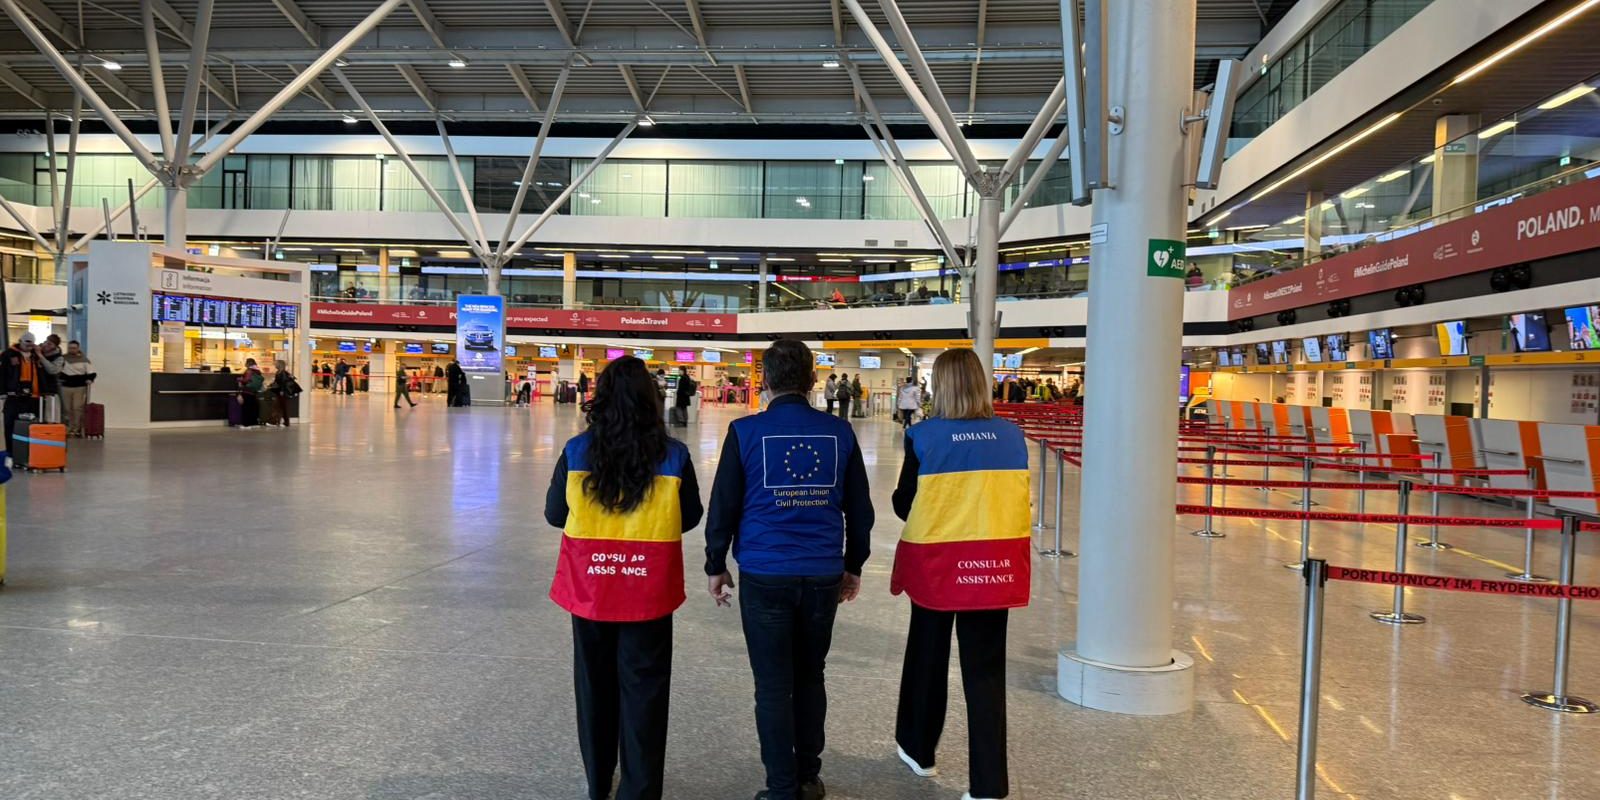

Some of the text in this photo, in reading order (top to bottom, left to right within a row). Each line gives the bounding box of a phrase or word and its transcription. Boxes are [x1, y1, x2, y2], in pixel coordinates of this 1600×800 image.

[1517, 206, 1584, 240] POLAND.
[1171, 258, 1185, 270] AED
[621, 317, 668, 325] Poland.Travel
[952, 432, 997, 442] ROMANIA
[773, 488, 830, 498] European Union
[792, 499, 829, 507] Protection
[957, 559, 1011, 569] CONSULAR
[587, 566, 647, 577] ASSISANCE
[956, 574, 1014, 584] ASSISTANCE
[1341, 569, 1377, 582] PORT
[1381, 572, 1449, 588] LOTNICZY
[1454, 579, 1476, 590] IM.
[1481, 580, 1564, 596] FRYDERYKA
